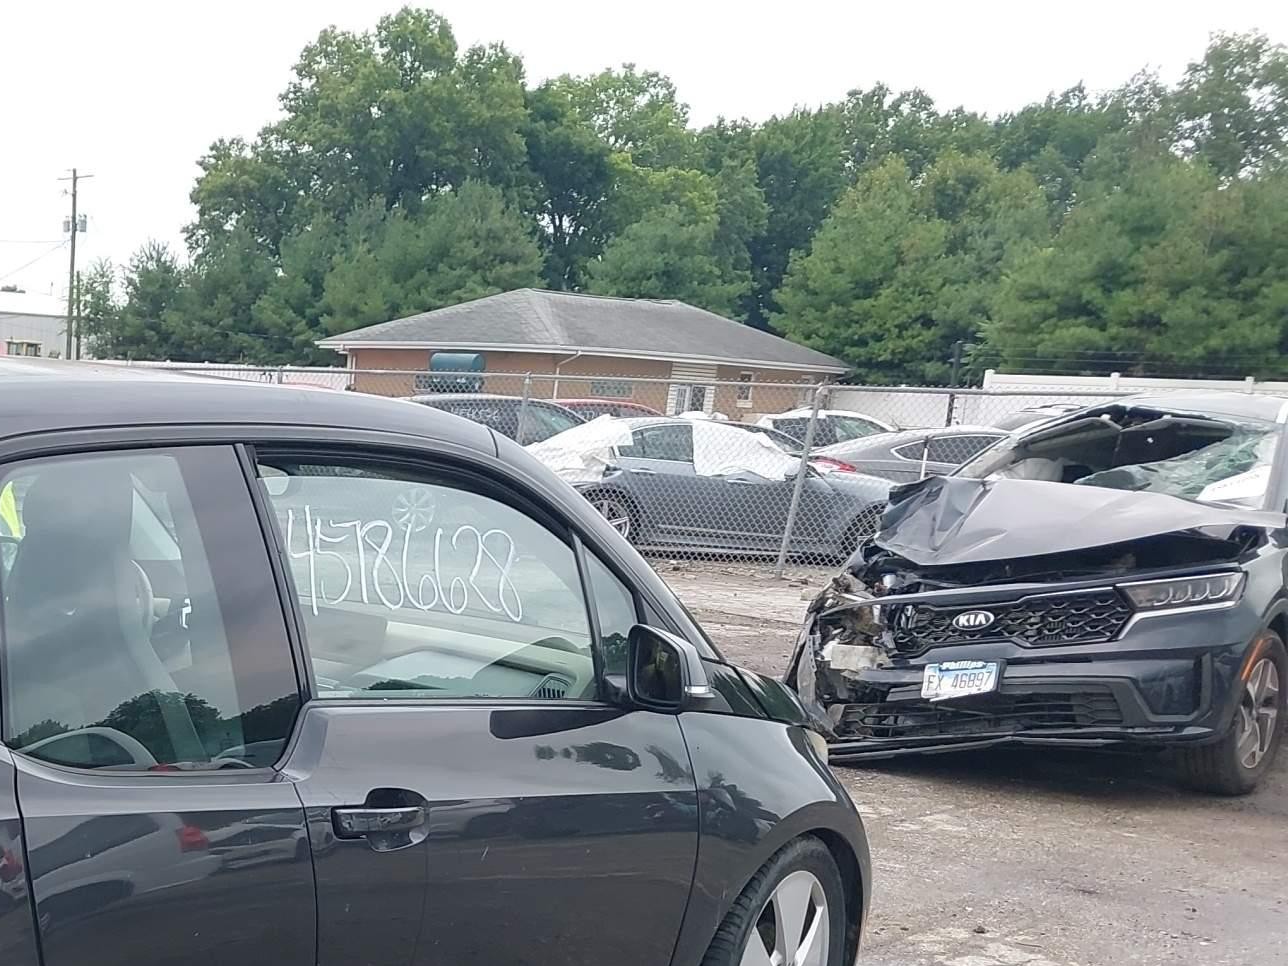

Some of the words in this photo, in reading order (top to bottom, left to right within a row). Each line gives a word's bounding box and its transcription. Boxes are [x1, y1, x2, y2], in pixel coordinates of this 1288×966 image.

[285, 504, 522, 622] 45786628
[958, 613, 987, 627] KIA
[926, 674, 945, 691] FX
